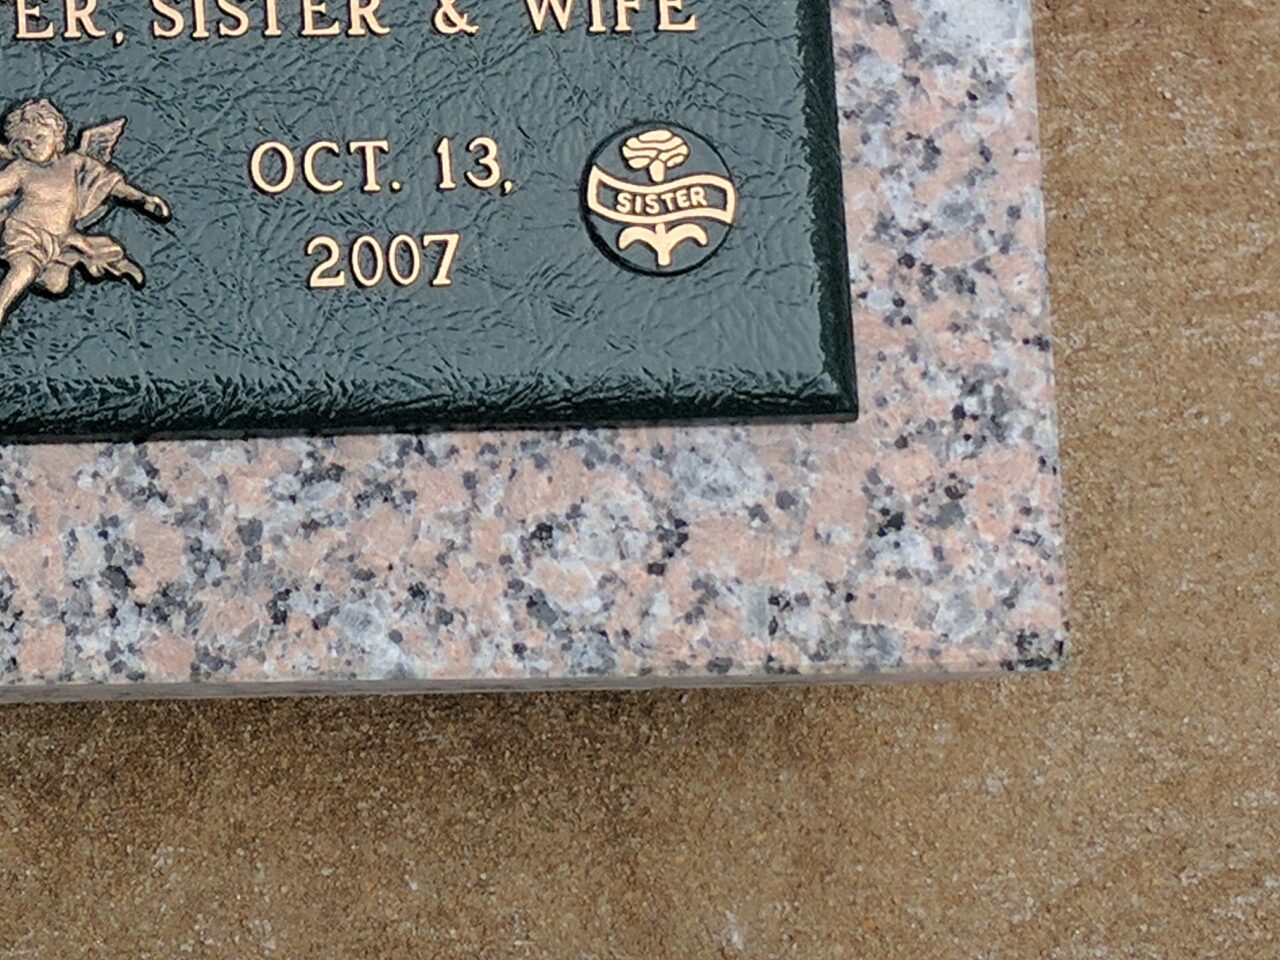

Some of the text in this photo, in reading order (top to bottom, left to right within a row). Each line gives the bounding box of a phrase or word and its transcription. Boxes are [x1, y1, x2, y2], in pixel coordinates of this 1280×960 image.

[251, 136, 513, 193] OCT. 13,
[616, 186, 708, 215] SISTER
[307, 233, 460, 288] 2007
